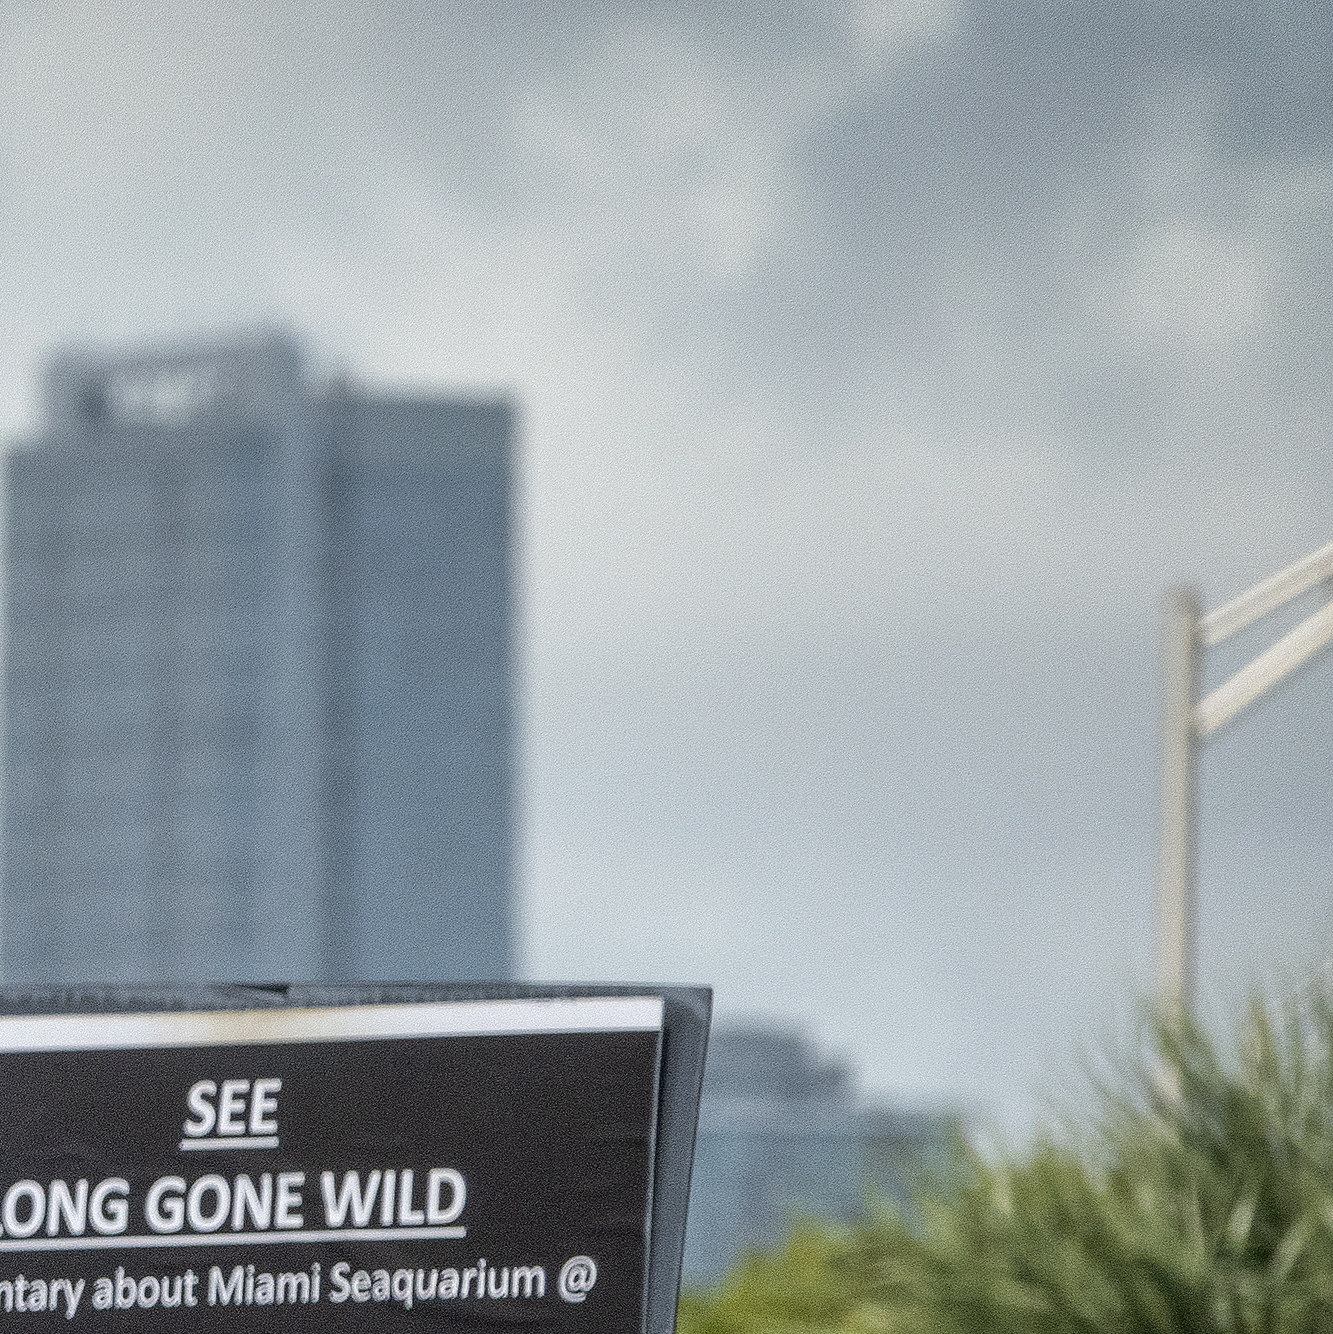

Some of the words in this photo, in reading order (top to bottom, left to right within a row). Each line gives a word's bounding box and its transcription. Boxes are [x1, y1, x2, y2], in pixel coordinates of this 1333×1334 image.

[184, 1078, 282, 1140] SEE
[145, 1171, 306, 1235] GONE
[320, 1168, 467, 1230] WILD
[93, 1265, 198, 1309] about
[207, 1261, 321, 1308] Miami
[329, 1258, 544, 1311] Seaquarium
[557, 1254, 598, 1304] @
